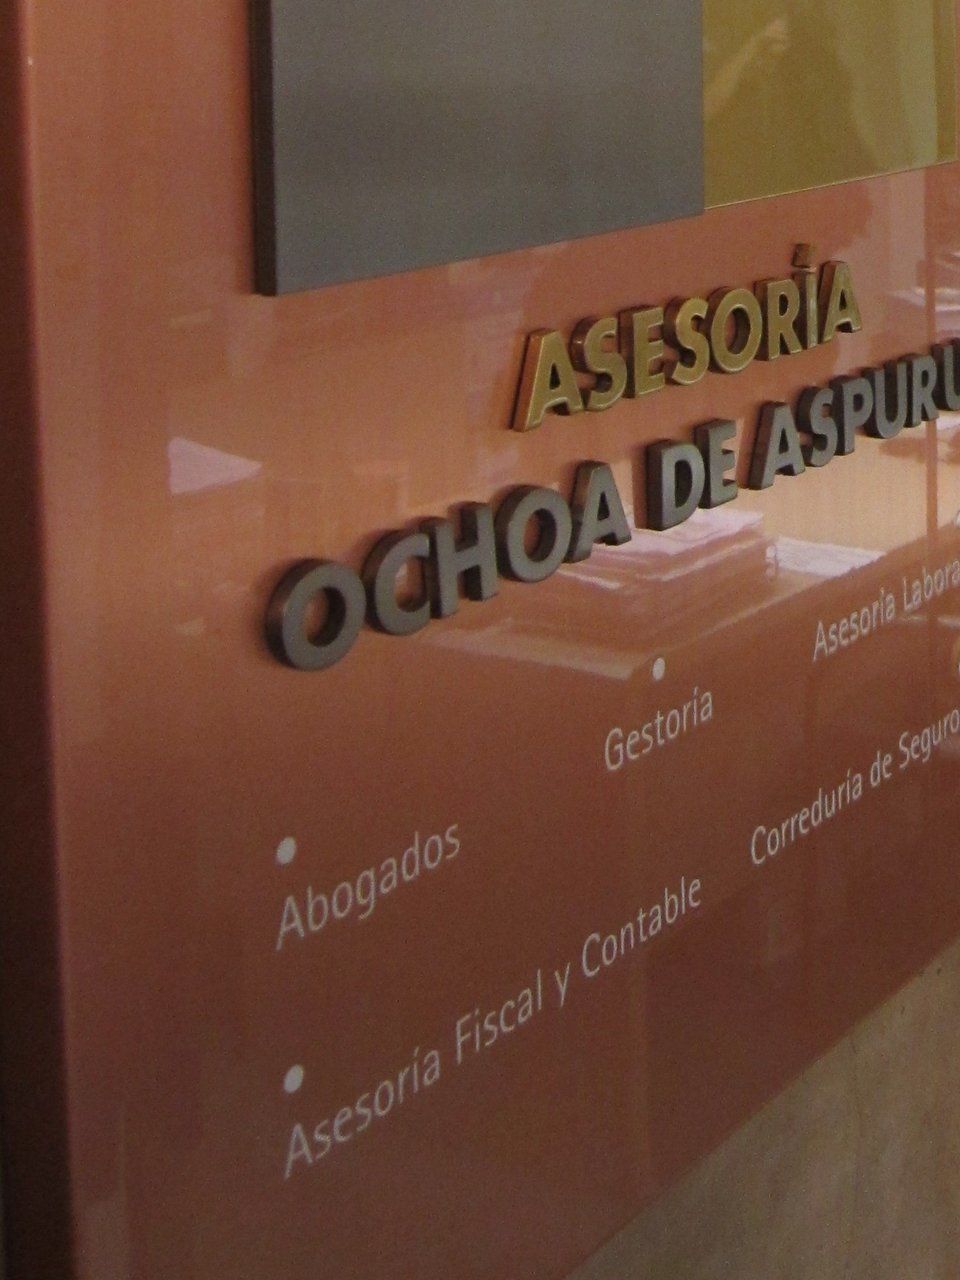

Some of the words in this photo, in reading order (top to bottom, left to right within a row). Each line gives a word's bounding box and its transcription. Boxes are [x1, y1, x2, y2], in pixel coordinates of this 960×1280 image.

[514, 243, 863, 432] ASESORÍA
[264, 460, 632, 671] OCHOA
[645, 421, 738, 531] DE
[812, 585, 896, 663] Asesoría
[604, 687, 714, 773] Gestoría
[750, 768, 863, 865] Correduría
[869, 750, 893, 789] de
[276, 824, 461, 951] Abogados
[285, 1049, 441, 1179] Asesoría
[454, 968, 543, 1066] Fiscal
[552, 963, 571, 1008] y
[580, 877, 702, 980] Contable
